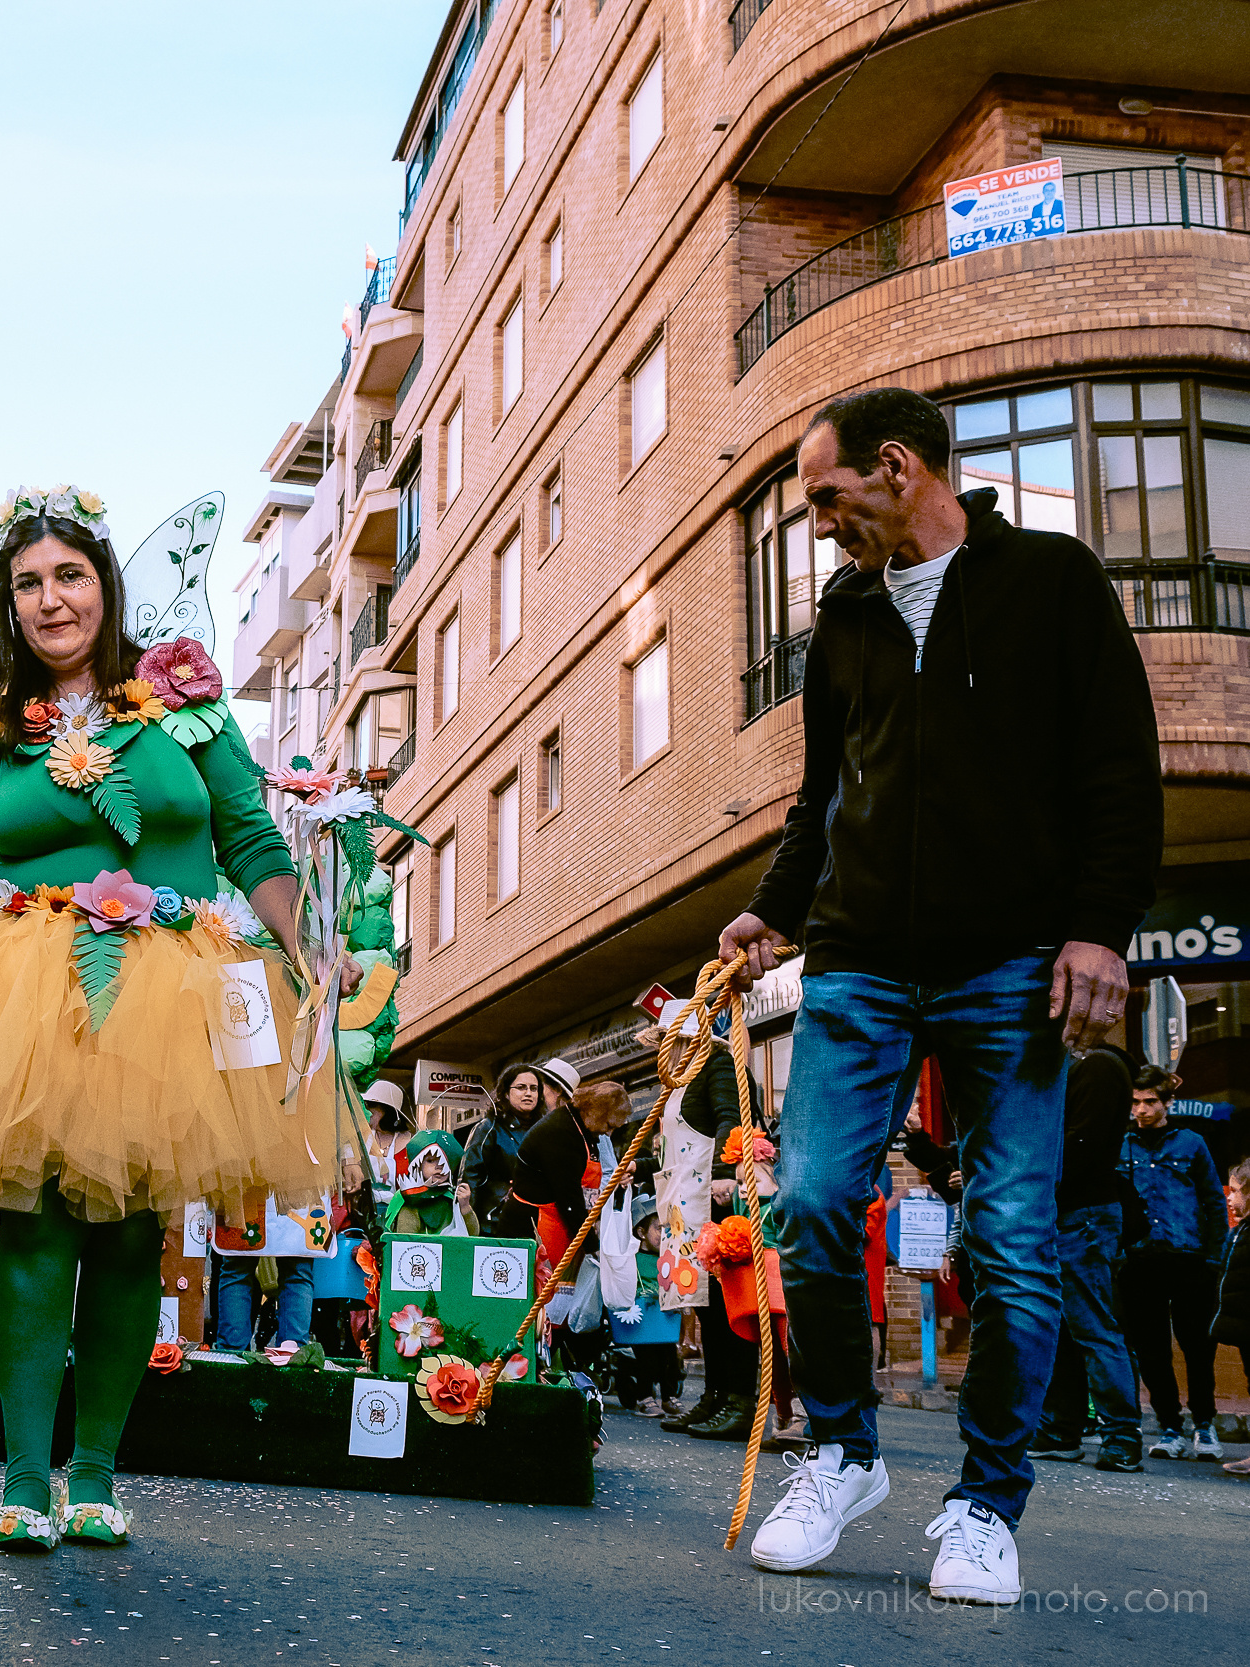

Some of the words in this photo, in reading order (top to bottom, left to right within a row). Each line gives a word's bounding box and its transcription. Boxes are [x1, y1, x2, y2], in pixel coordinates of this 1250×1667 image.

[979, 176, 999, 192] SE
[1003, 163, 1060, 187] VENDE
[976, 200, 1009, 212] MANUEL
[1011, 193, 1041, 204] RICOTE
[997, 191, 1019, 200] TEAM
[973, 214, 990, 224] 966
[992, 208, 1010, 219] 700
[1013, 205, 1029, 214] 368
[951, 229, 987, 251] 664
[992, 220, 1027, 240] 778
[1031, 214, 1064, 232] 316
[1010, 232, 1036, 242] VISTA
[237, 978, 258, 991] Project
[430, 1072, 483, 1084] COMPUTER
[1169, 1100, 1214, 1119] ENIDO
